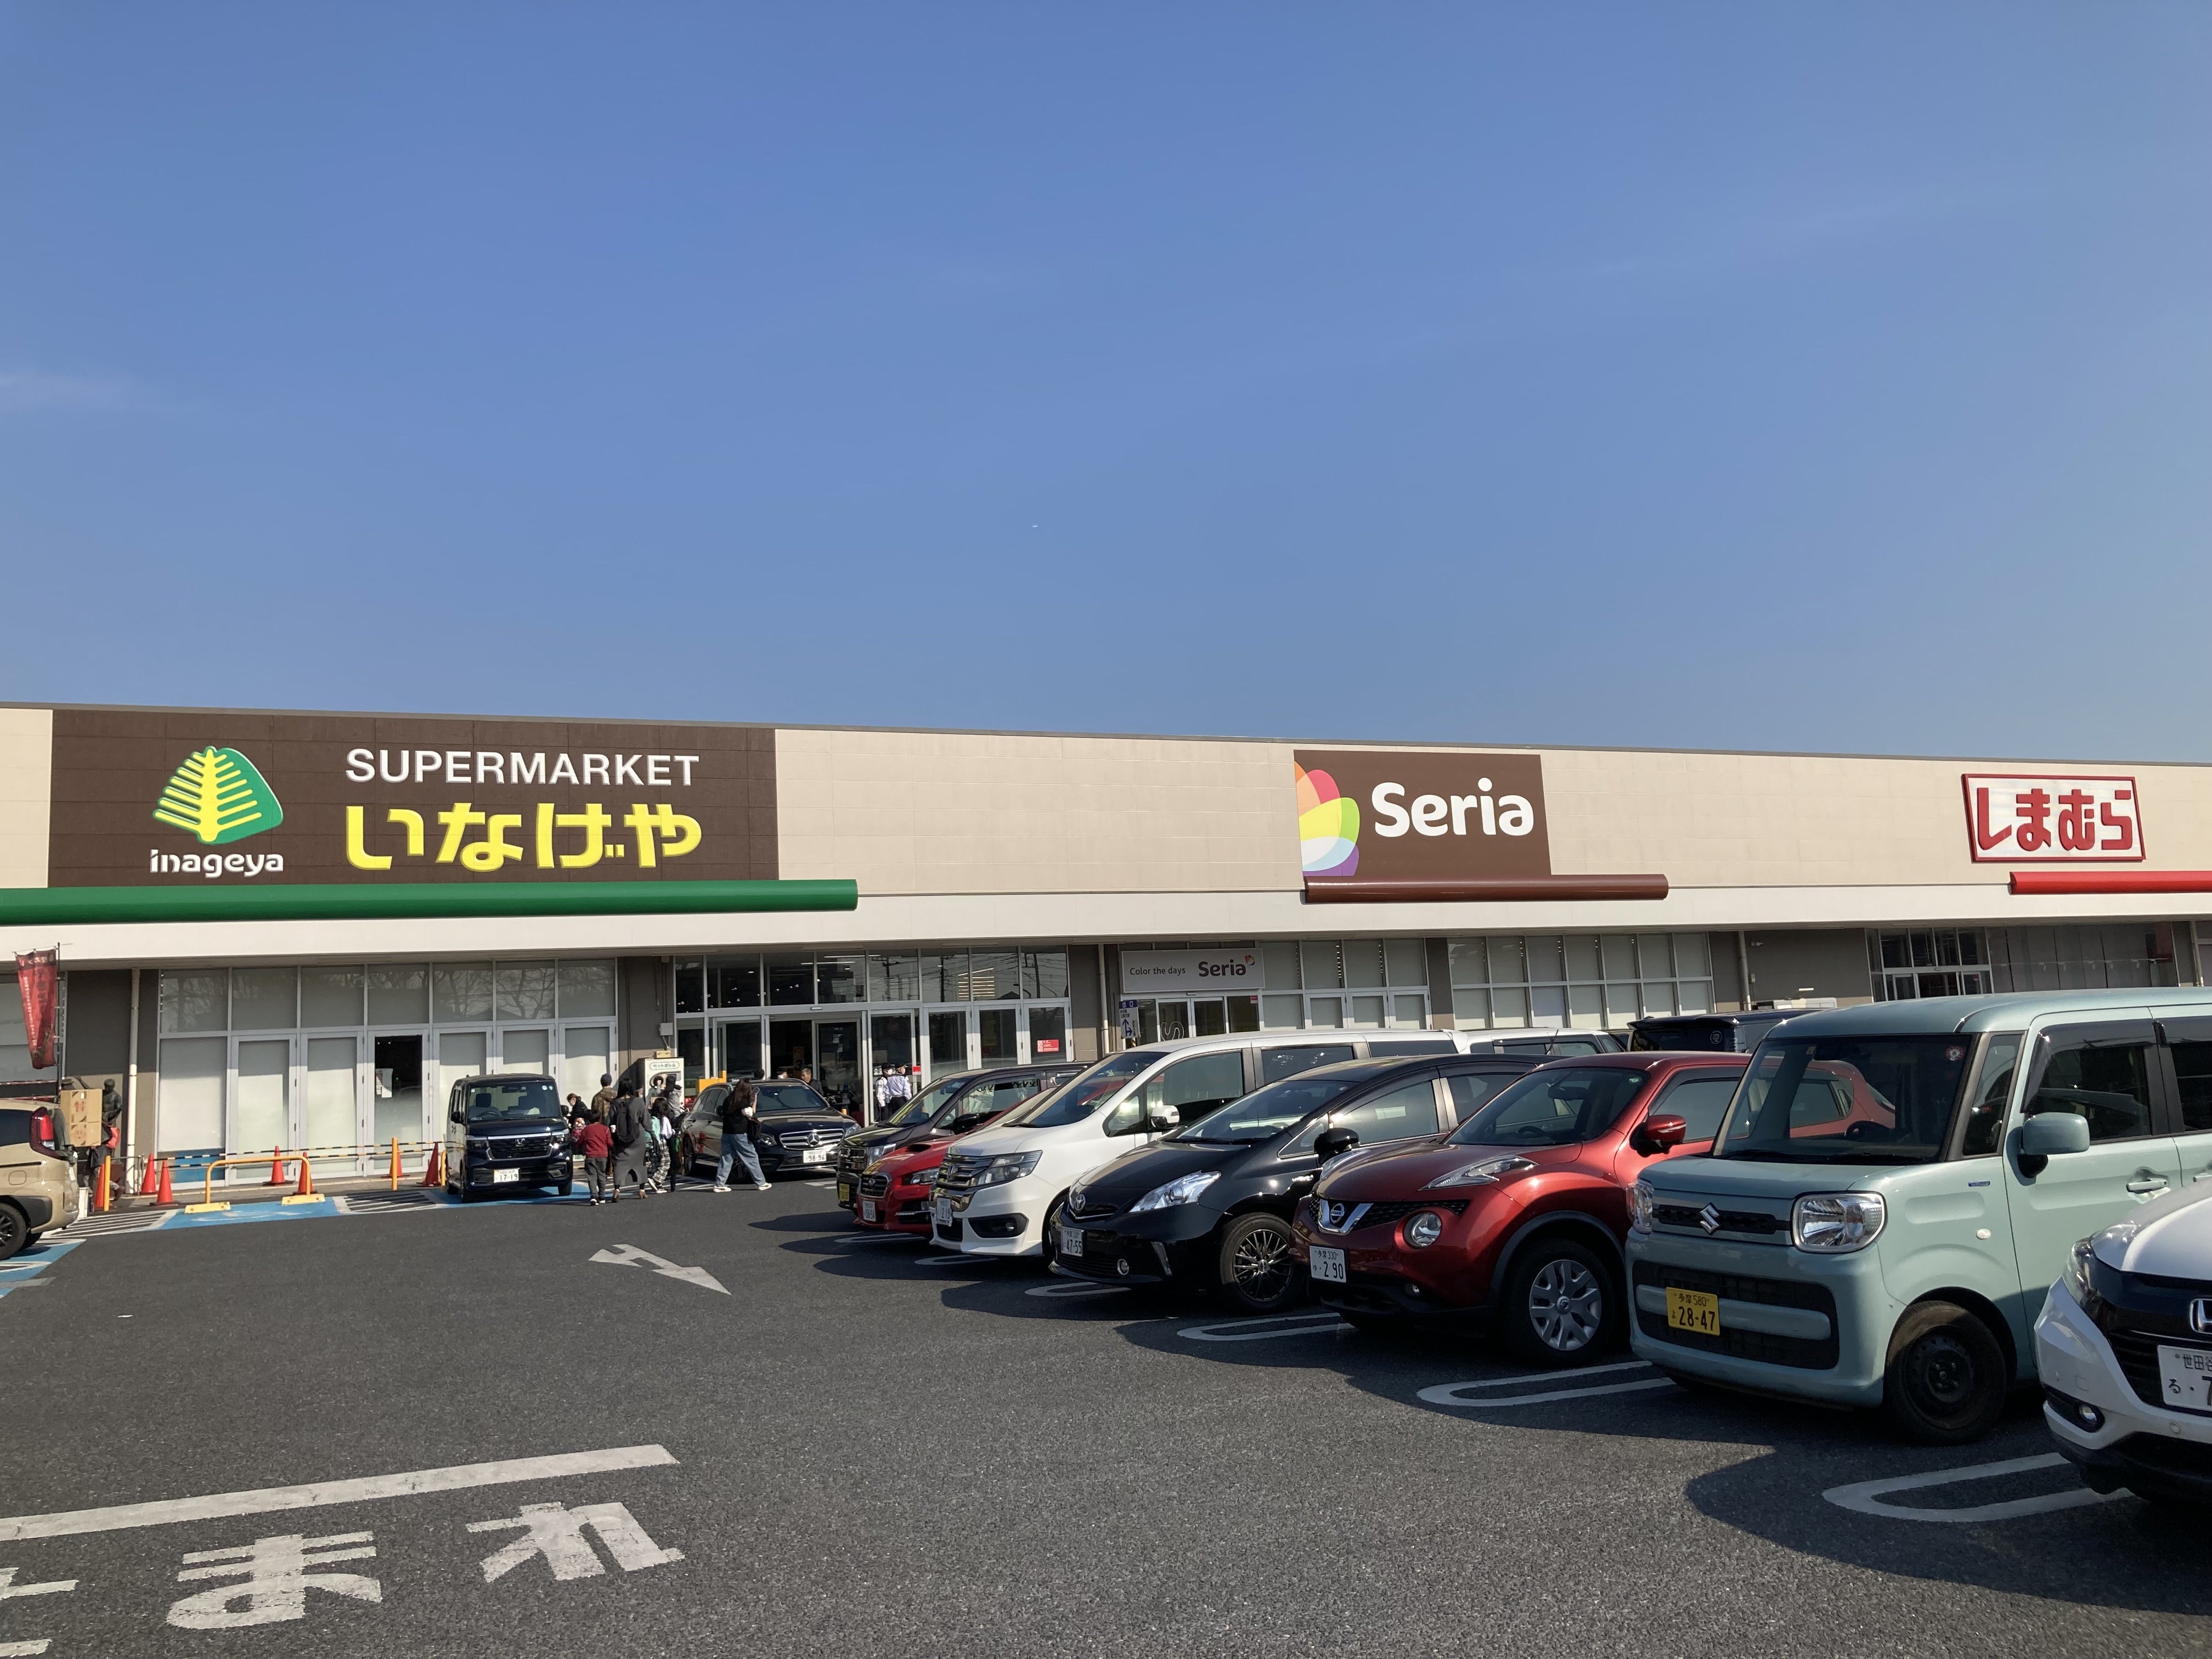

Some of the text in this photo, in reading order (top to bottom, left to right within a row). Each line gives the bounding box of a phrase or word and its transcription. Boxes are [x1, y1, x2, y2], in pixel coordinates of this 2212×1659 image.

[345, 748, 699, 786] SUPERMARKET
[1372, 777, 1534, 837] Seria
[1976, 787, 2133, 851] しまむら
[346, 802, 702, 872] いなげや
[150, 849, 284, 878] inageya
[1153, 966, 1165, 974] the
[1168, 966, 1186, 976] days
[1198, 959, 1246, 977] Seria
[1066, 1239, 1082, 1254] 47-55
[1678, 1306, 1716, 1331] 28-47
[2169, 1379, 2181, 1394] る
